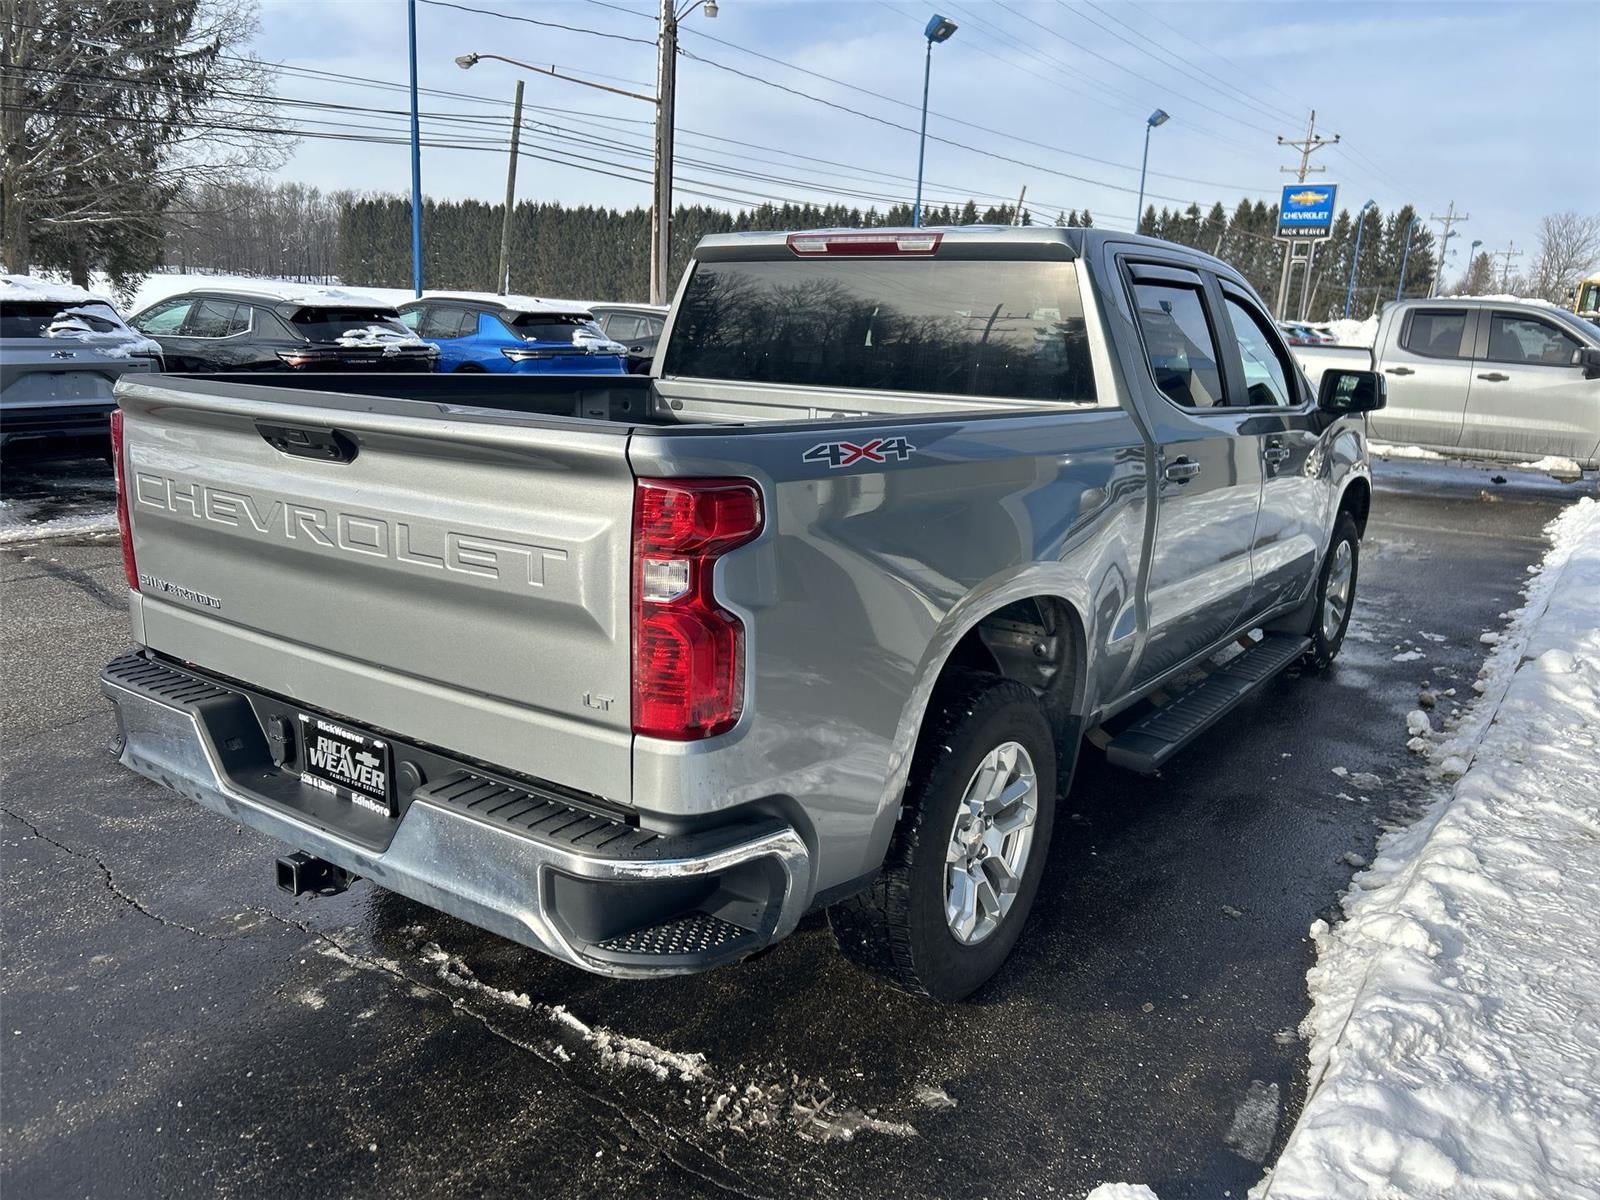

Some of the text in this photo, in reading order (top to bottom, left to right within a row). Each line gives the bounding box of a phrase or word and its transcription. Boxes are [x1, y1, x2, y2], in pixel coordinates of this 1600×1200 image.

[1283, 211, 1328, 220] CHEVROLET
[1281, 228, 1326, 236] RICK WEAVER
[136, 471, 568, 587] CHEVROLET
[140, 573, 221, 609] SILVERADO
[582, 692, 614, 711] LT
[317, 735, 352, 760] RICK
[309, 747, 385, 790] WEAVER
[330, 771, 385, 796] FAMOUS FOR SERVICE
[351, 792, 391, 817] Edinboro
